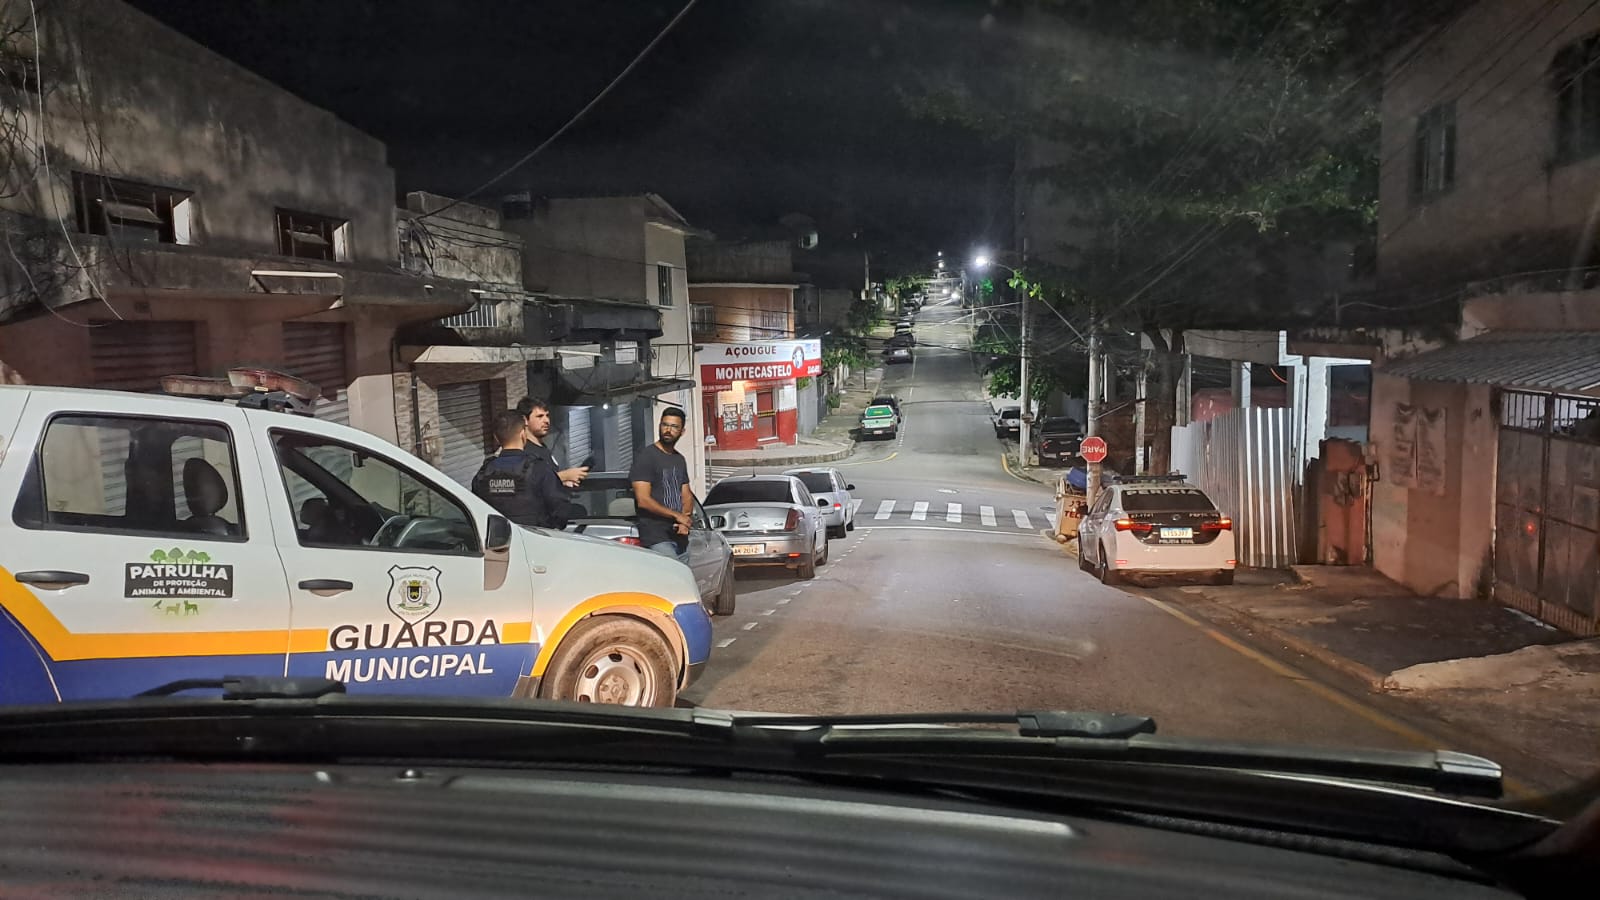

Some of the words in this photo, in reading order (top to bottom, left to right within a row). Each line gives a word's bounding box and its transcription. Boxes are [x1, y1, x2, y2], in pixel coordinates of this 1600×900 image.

[725, 345, 777, 358] AÇOUGUE
[715, 364, 792, 380] MONTECASTELO
[1082, 445, 1105, 453] PARE
[489, 479, 515, 488] GUARDA
[129, 564, 228, 580] PATRULHA
[166, 579, 207, 587] PROTEÇÃO
[132, 588, 167, 596] ANIMAL
[177, 588, 226, 597] AMBIENTAL
[329, 619, 501, 651] GUARDA
[325, 653, 494, 683] MUNICIPAL
